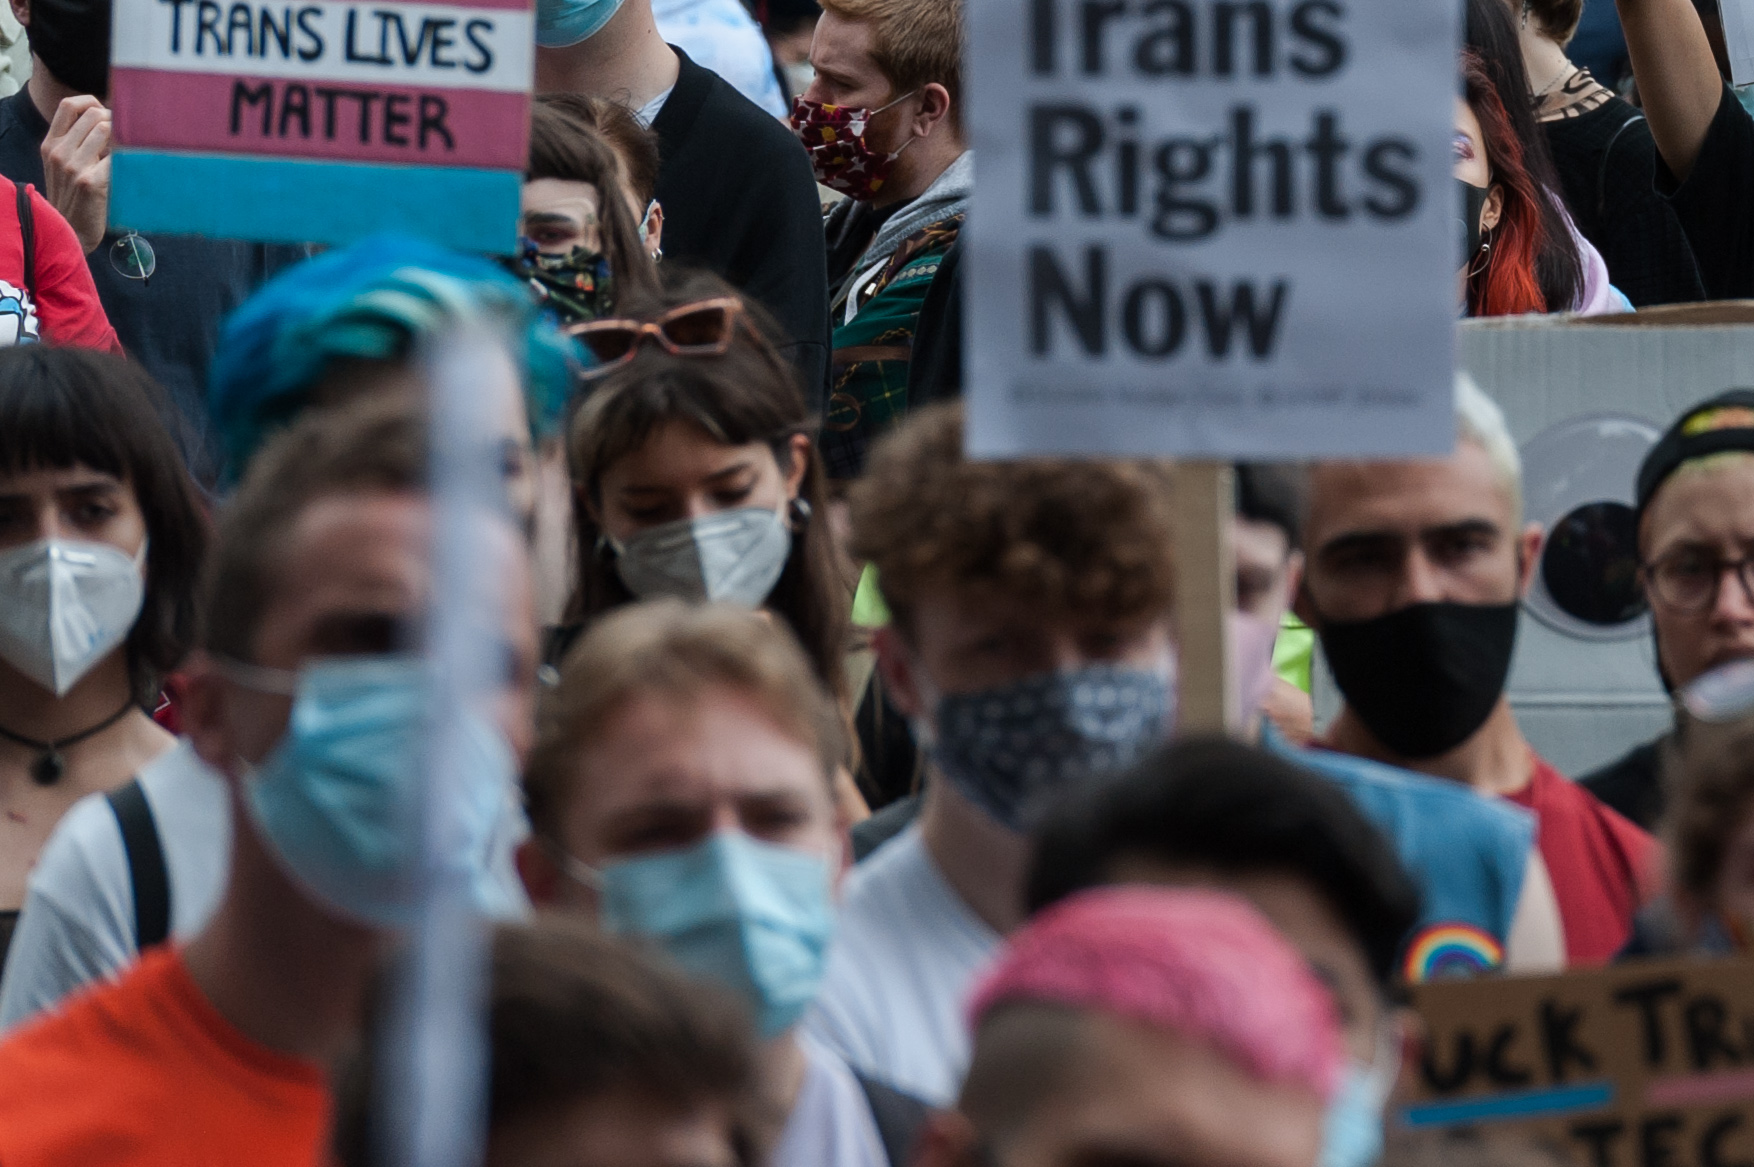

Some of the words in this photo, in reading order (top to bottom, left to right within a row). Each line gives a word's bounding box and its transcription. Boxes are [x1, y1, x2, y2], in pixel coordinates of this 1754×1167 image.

[344, 7, 496, 74] LIVES
[229, 78, 456, 151] MATTER
[1026, 102, 1425, 243] Rights
[1026, 244, 1290, 362] Now
[1423, 997, 1598, 1093] UCK
